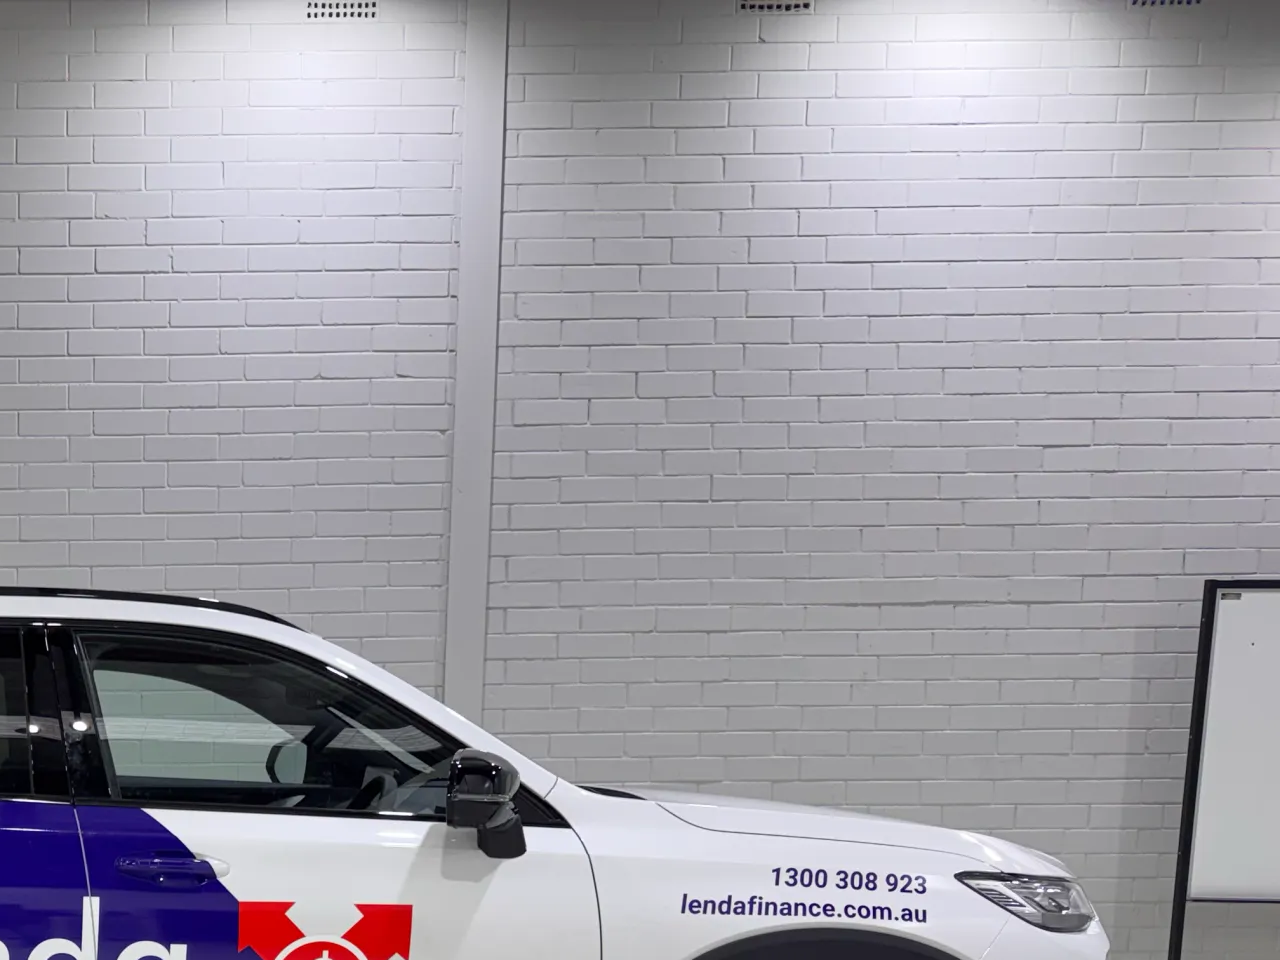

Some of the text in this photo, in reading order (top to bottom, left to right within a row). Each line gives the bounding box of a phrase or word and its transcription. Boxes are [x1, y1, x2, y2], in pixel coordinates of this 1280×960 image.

[771, 867, 928, 895] 1300 308 923
[680, 893, 928, 923] lendafinance.com.au
